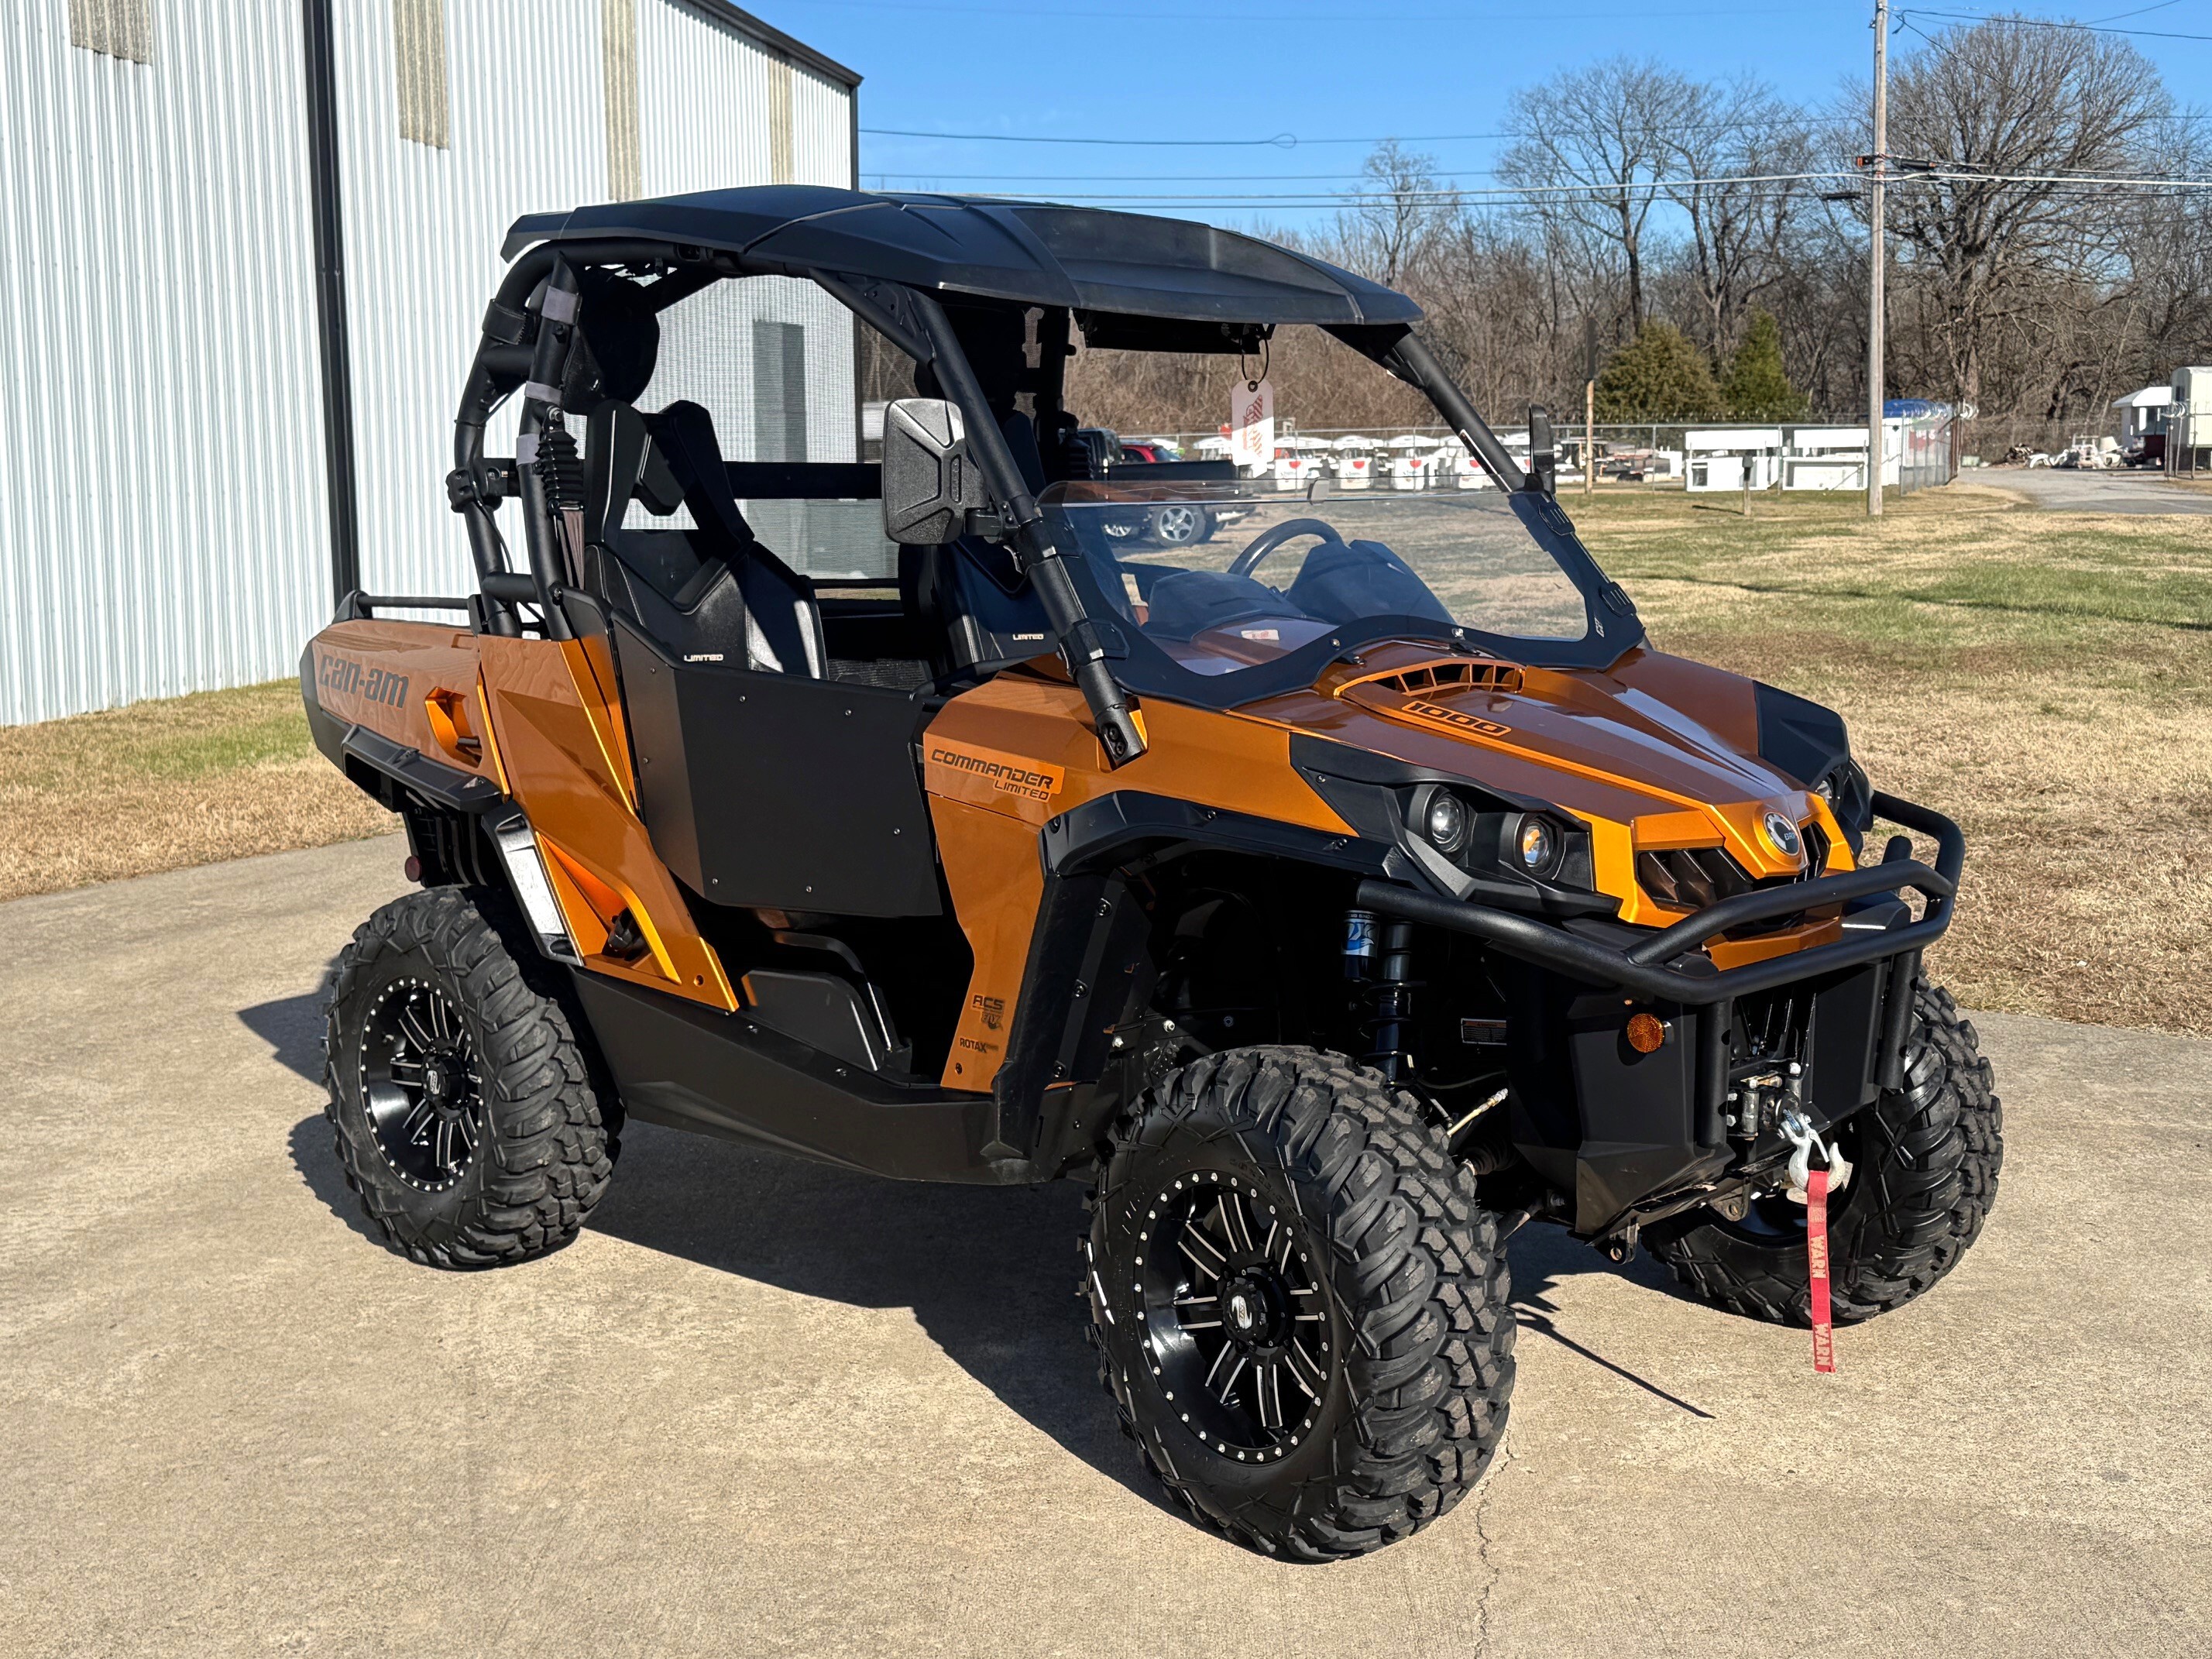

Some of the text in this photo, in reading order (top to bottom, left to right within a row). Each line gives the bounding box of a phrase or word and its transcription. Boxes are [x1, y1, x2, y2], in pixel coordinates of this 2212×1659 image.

[1407, 702, 1506, 733] 1000
[931, 748, 1054, 789] COMMANDER
[994, 780, 1050, 801] LIMITED
[972, 994, 1005, 1010] ACS
[960, 1037, 987, 1053] ROTAX
[1810, 1235, 1826, 1279] WARN
[1814, 1322, 1830, 1366] WARN
